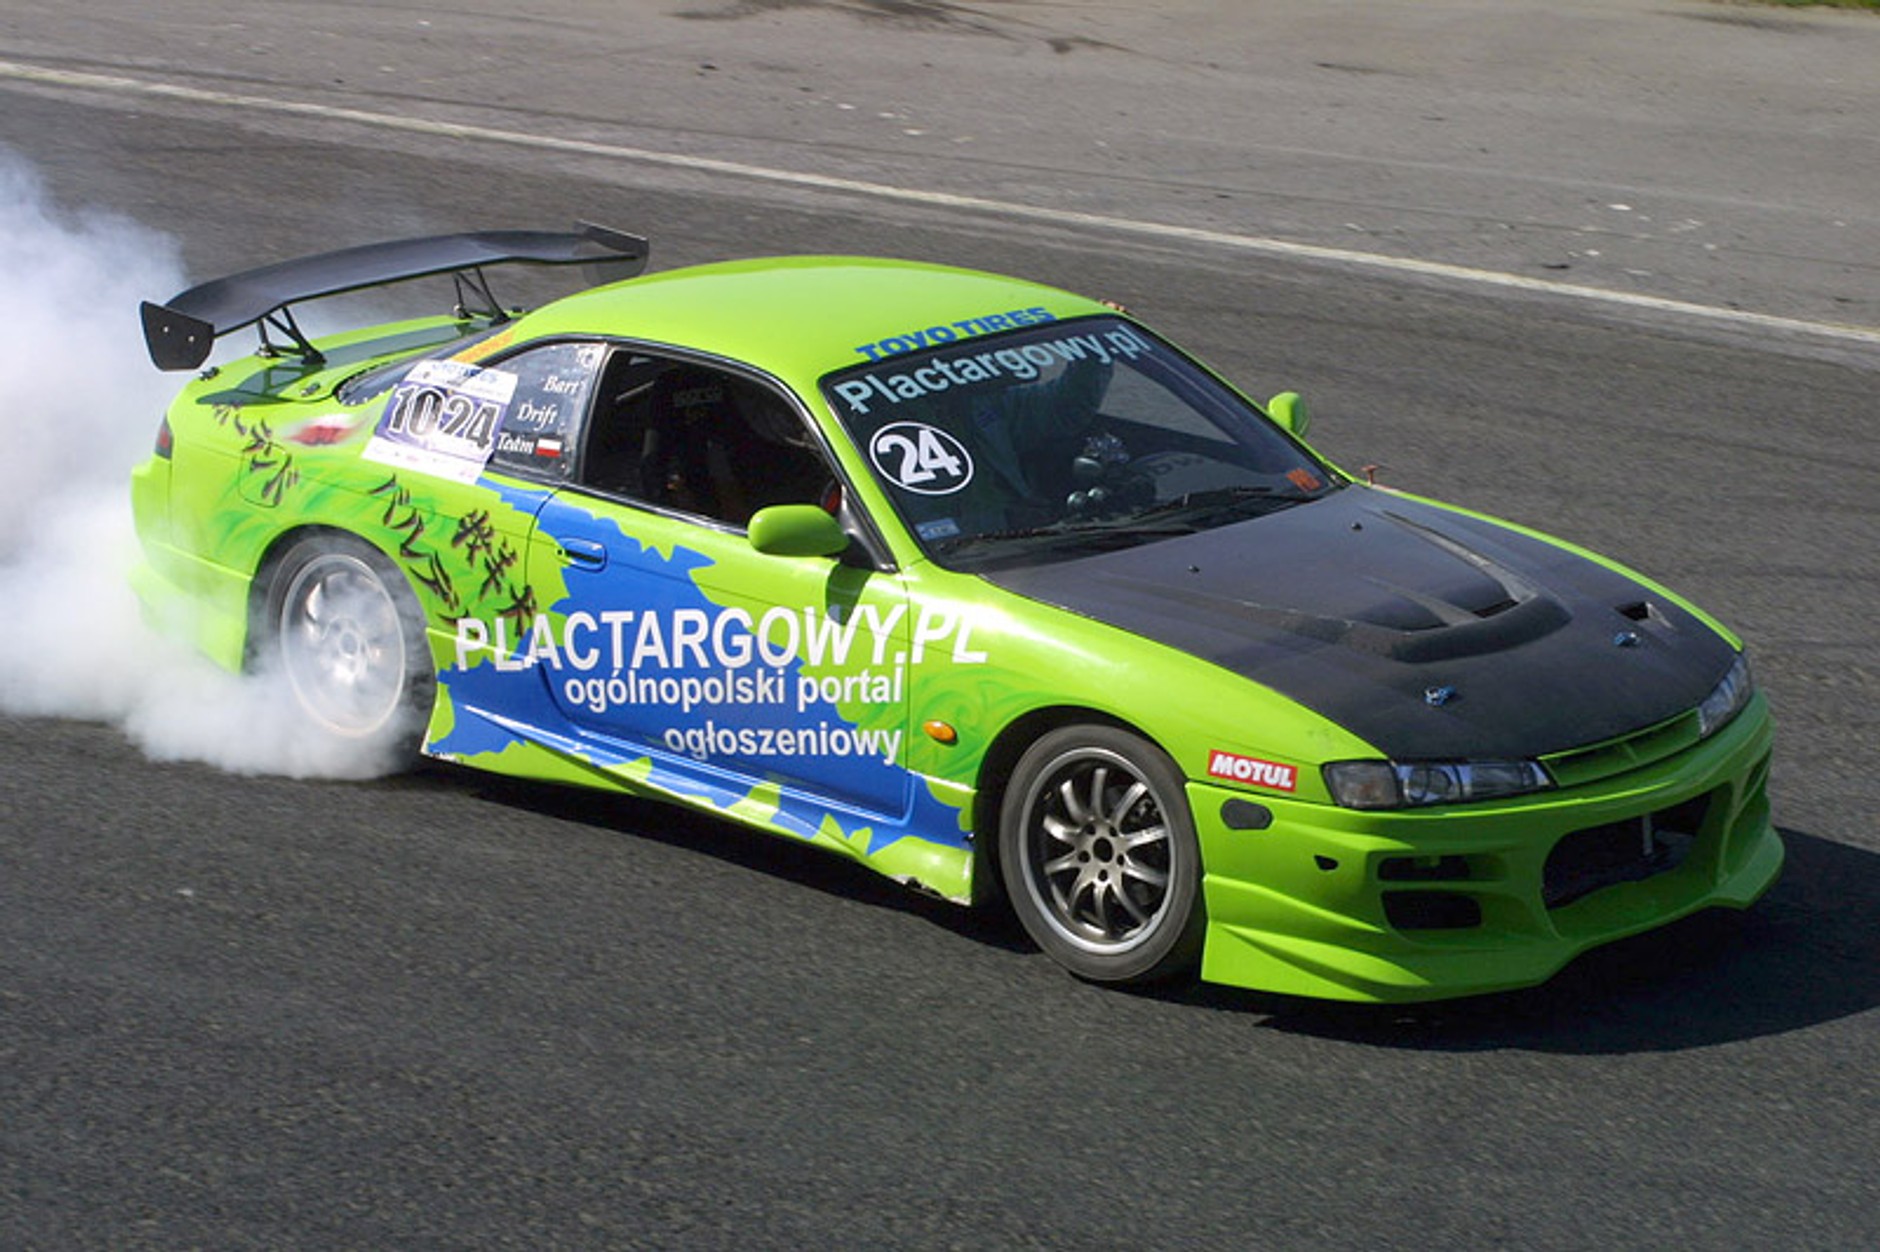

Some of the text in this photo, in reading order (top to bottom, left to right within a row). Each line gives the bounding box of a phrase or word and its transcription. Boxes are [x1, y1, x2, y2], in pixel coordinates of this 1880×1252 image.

[856, 307, 1057, 363] TOYO TIRES
[834, 324, 1150, 414] Plactargowy.pl
[516, 401, 559, 432] Drift
[876, 428, 963, 486] 24
[454, 602, 988, 672] PLACTARGOWY.PL
[563, 668, 902, 713] ogólnopolski portal
[664, 720, 902, 766] ogłoszeniowy
[1209, 753, 1293, 789] MOTUL
